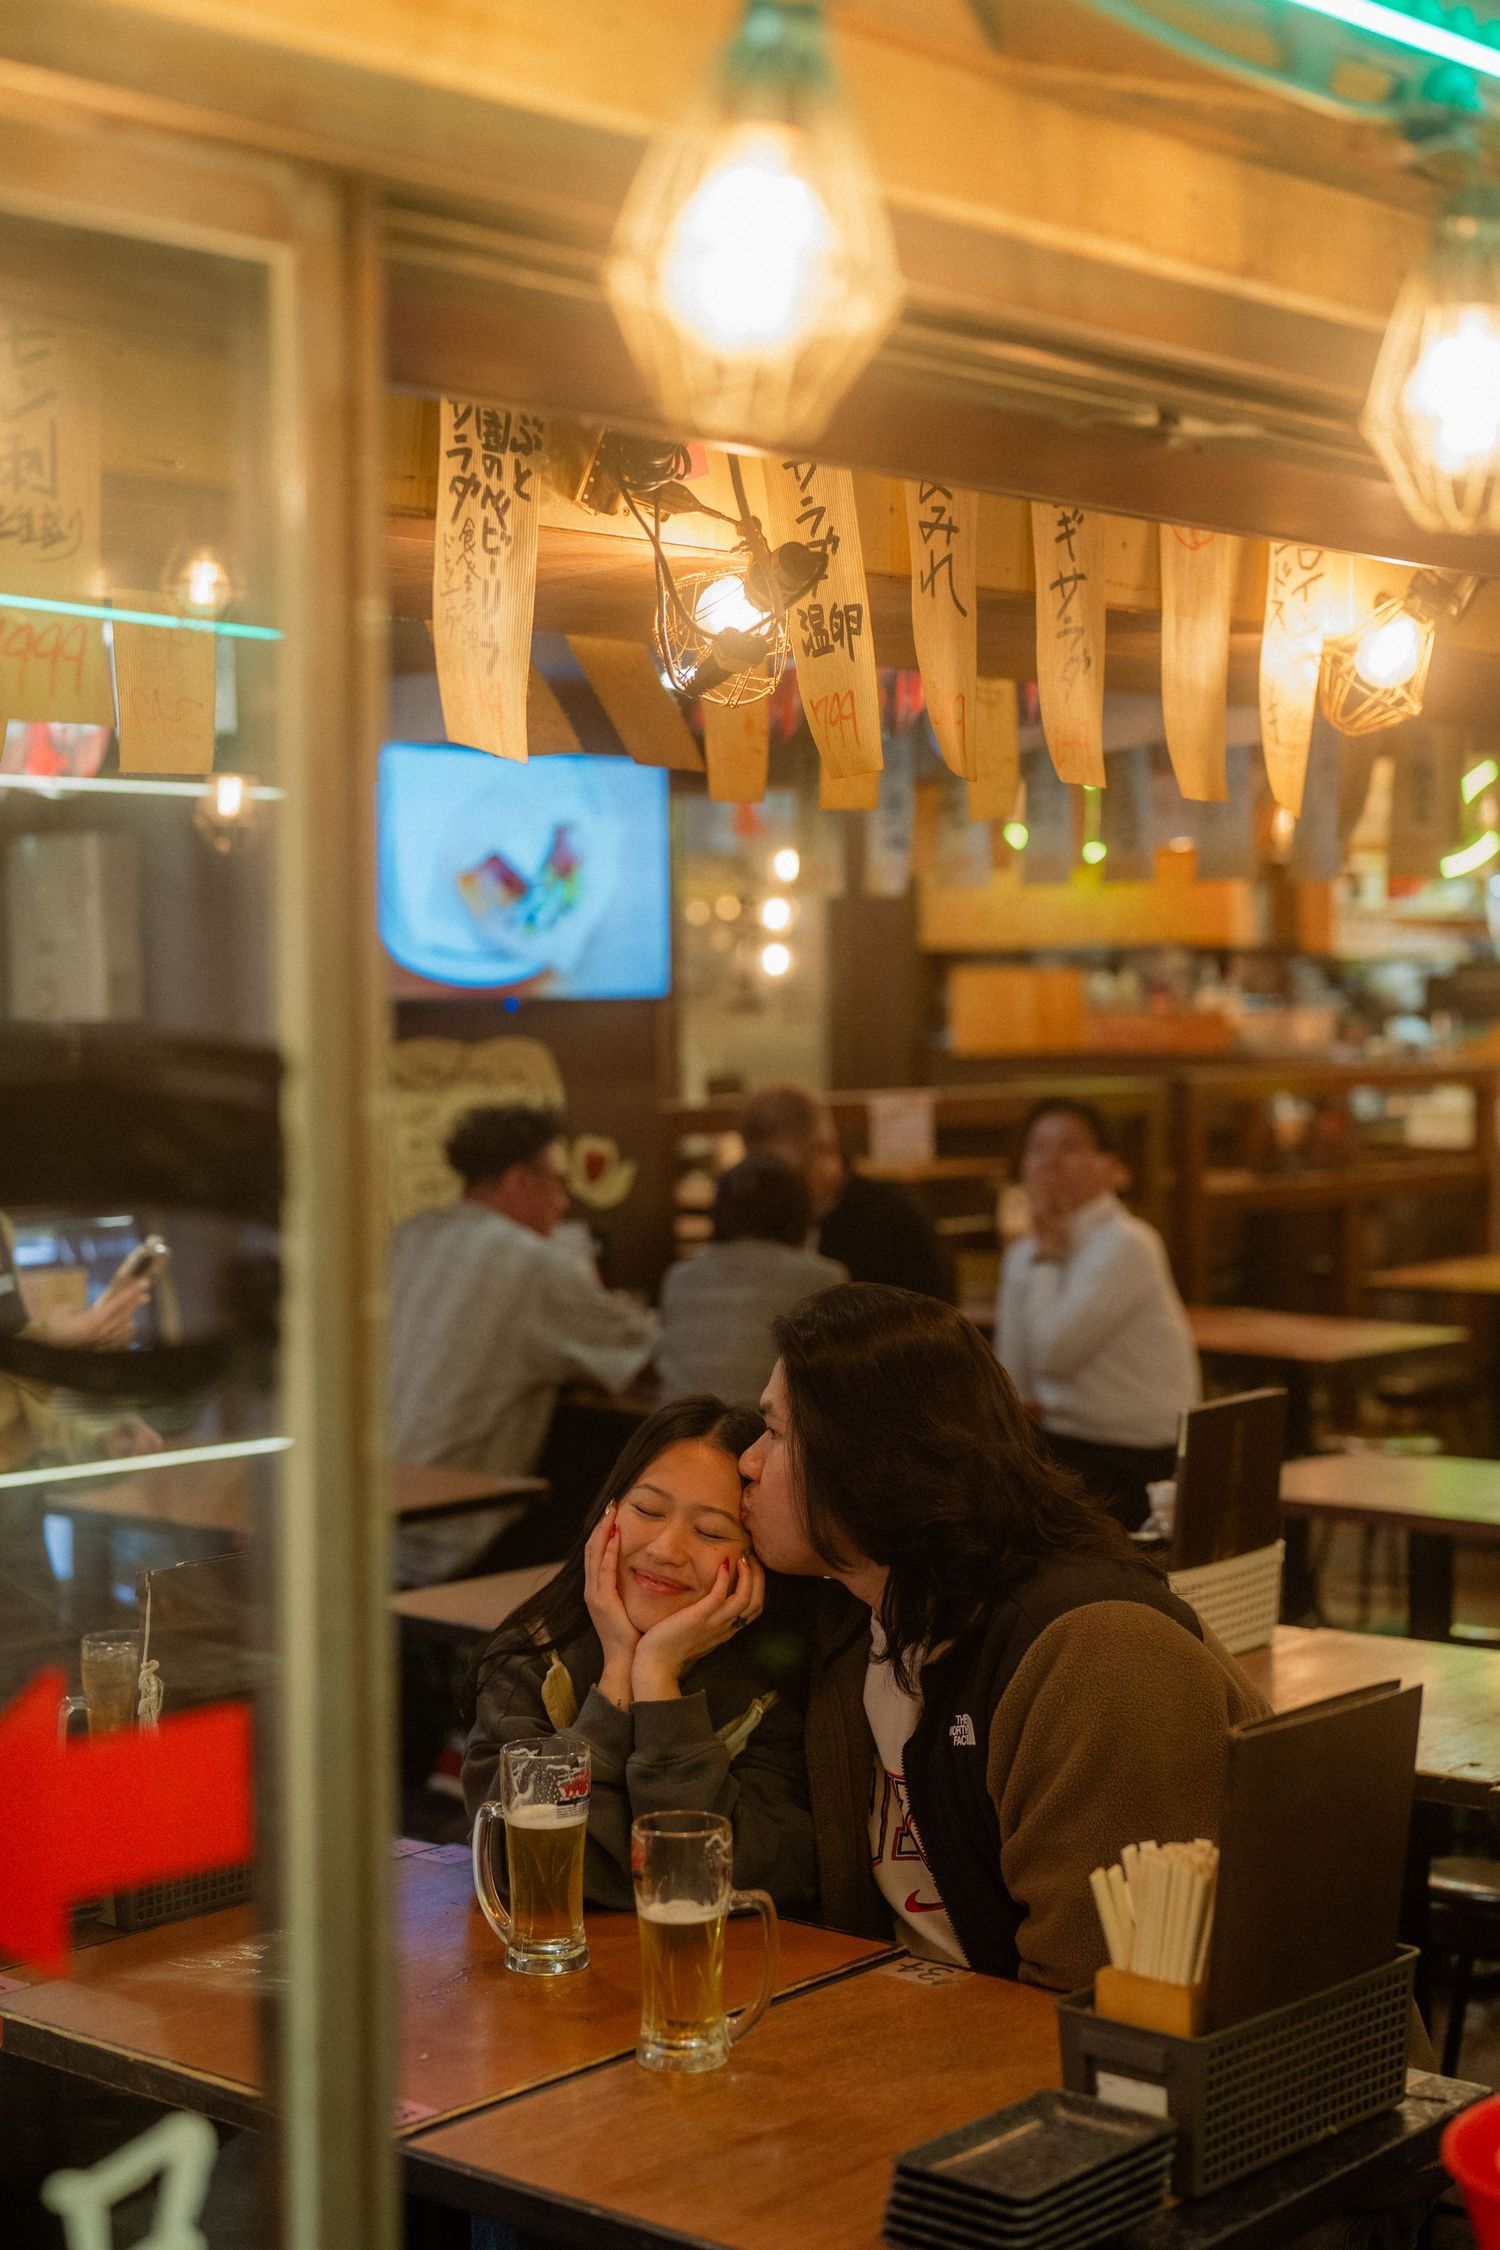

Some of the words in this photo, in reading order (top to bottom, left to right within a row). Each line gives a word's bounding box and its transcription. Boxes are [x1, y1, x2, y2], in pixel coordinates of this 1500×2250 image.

[1050, 504, 1092, 704] ギサラダ
[955, 1714, 969, 1725] THE
